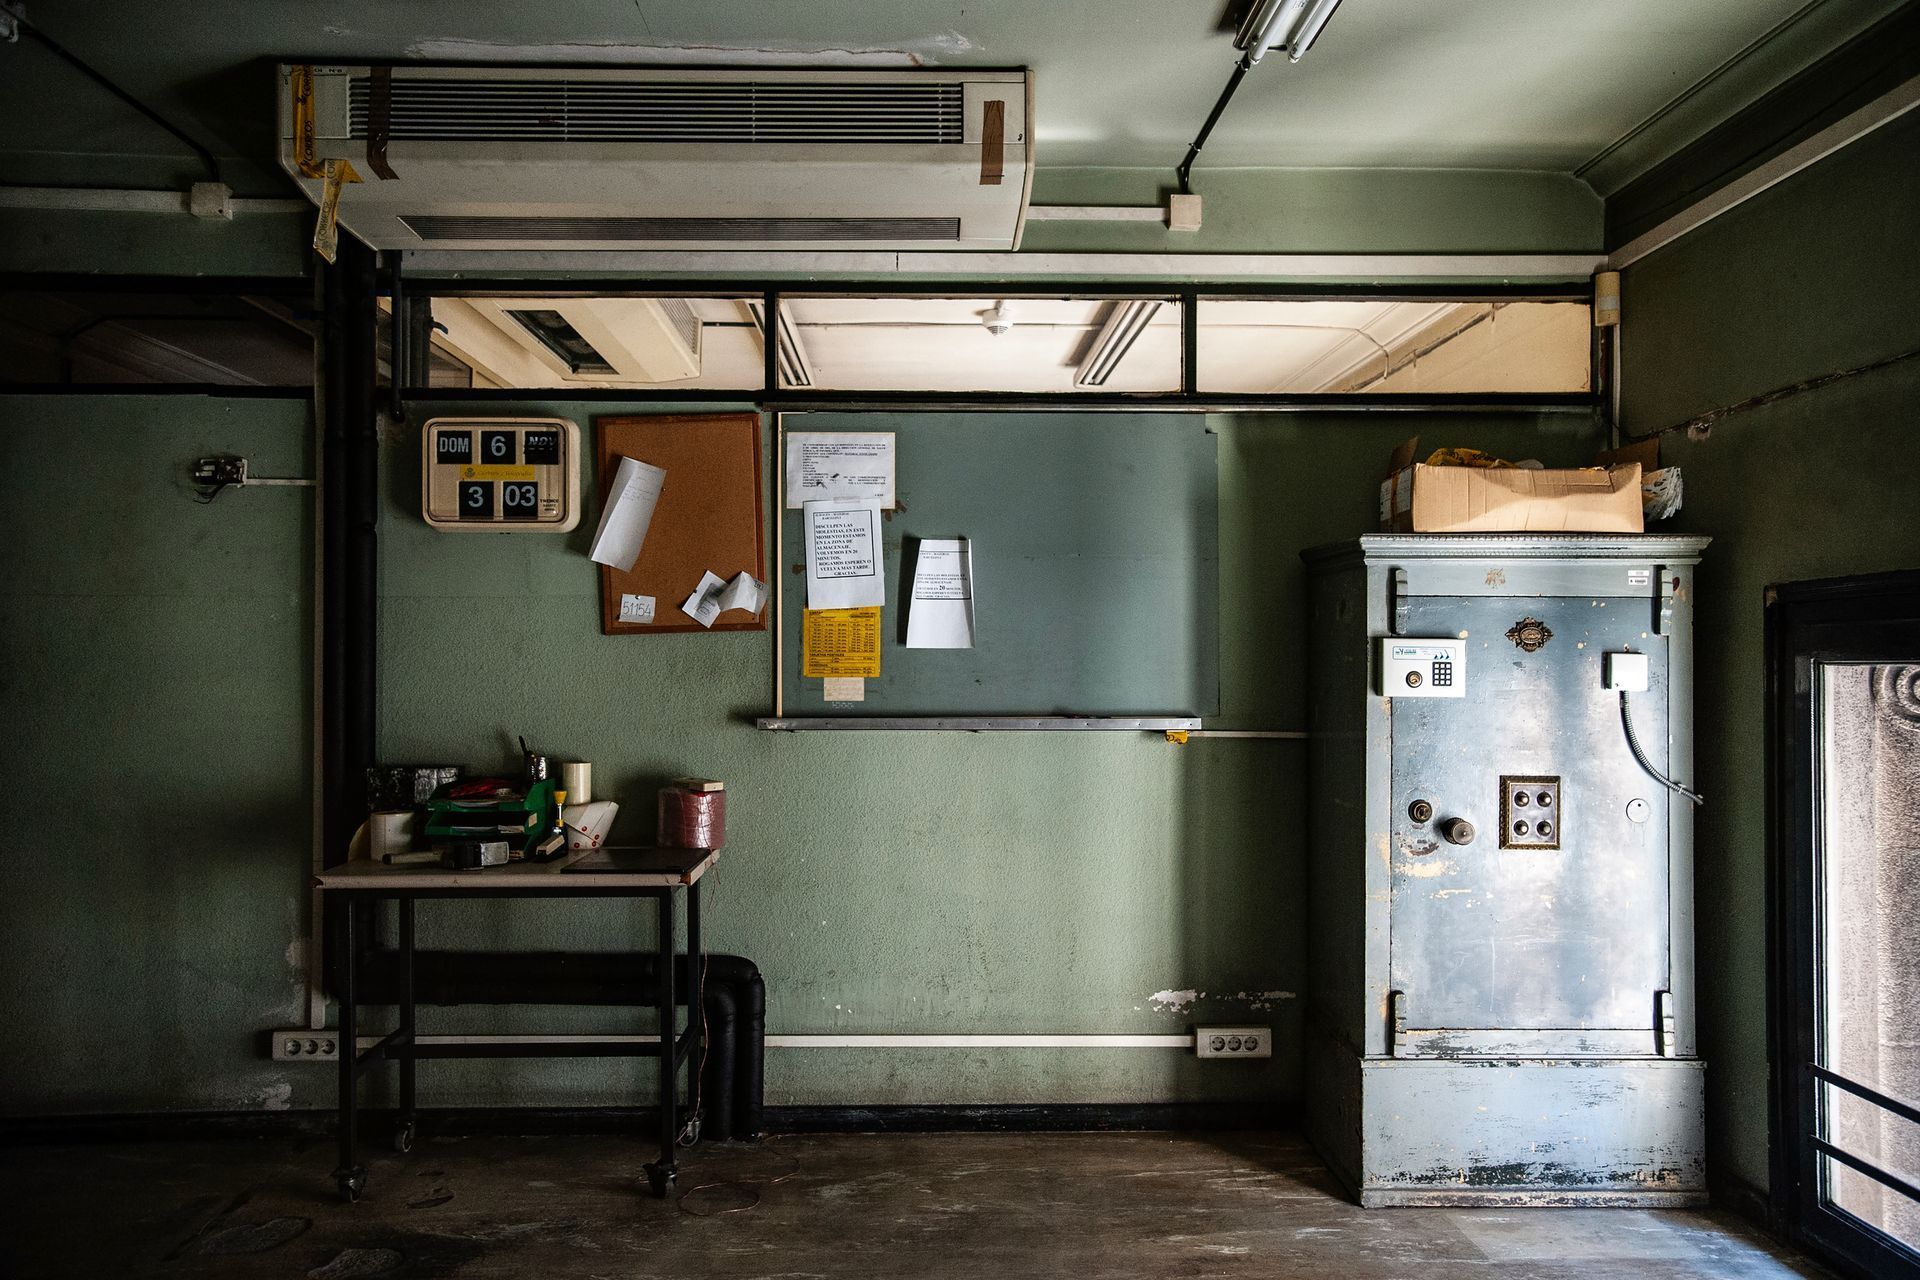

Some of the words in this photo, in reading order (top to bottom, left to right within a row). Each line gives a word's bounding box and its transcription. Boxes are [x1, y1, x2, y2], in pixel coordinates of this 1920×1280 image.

[304, 120, 313, 162] CORREOS
[440, 437, 469, 453] DOM
[491, 435, 506, 456] 6
[468, 486, 483, 508] 3
[505, 485, 535, 507] 03
[622, 601, 651, 617] 51154
